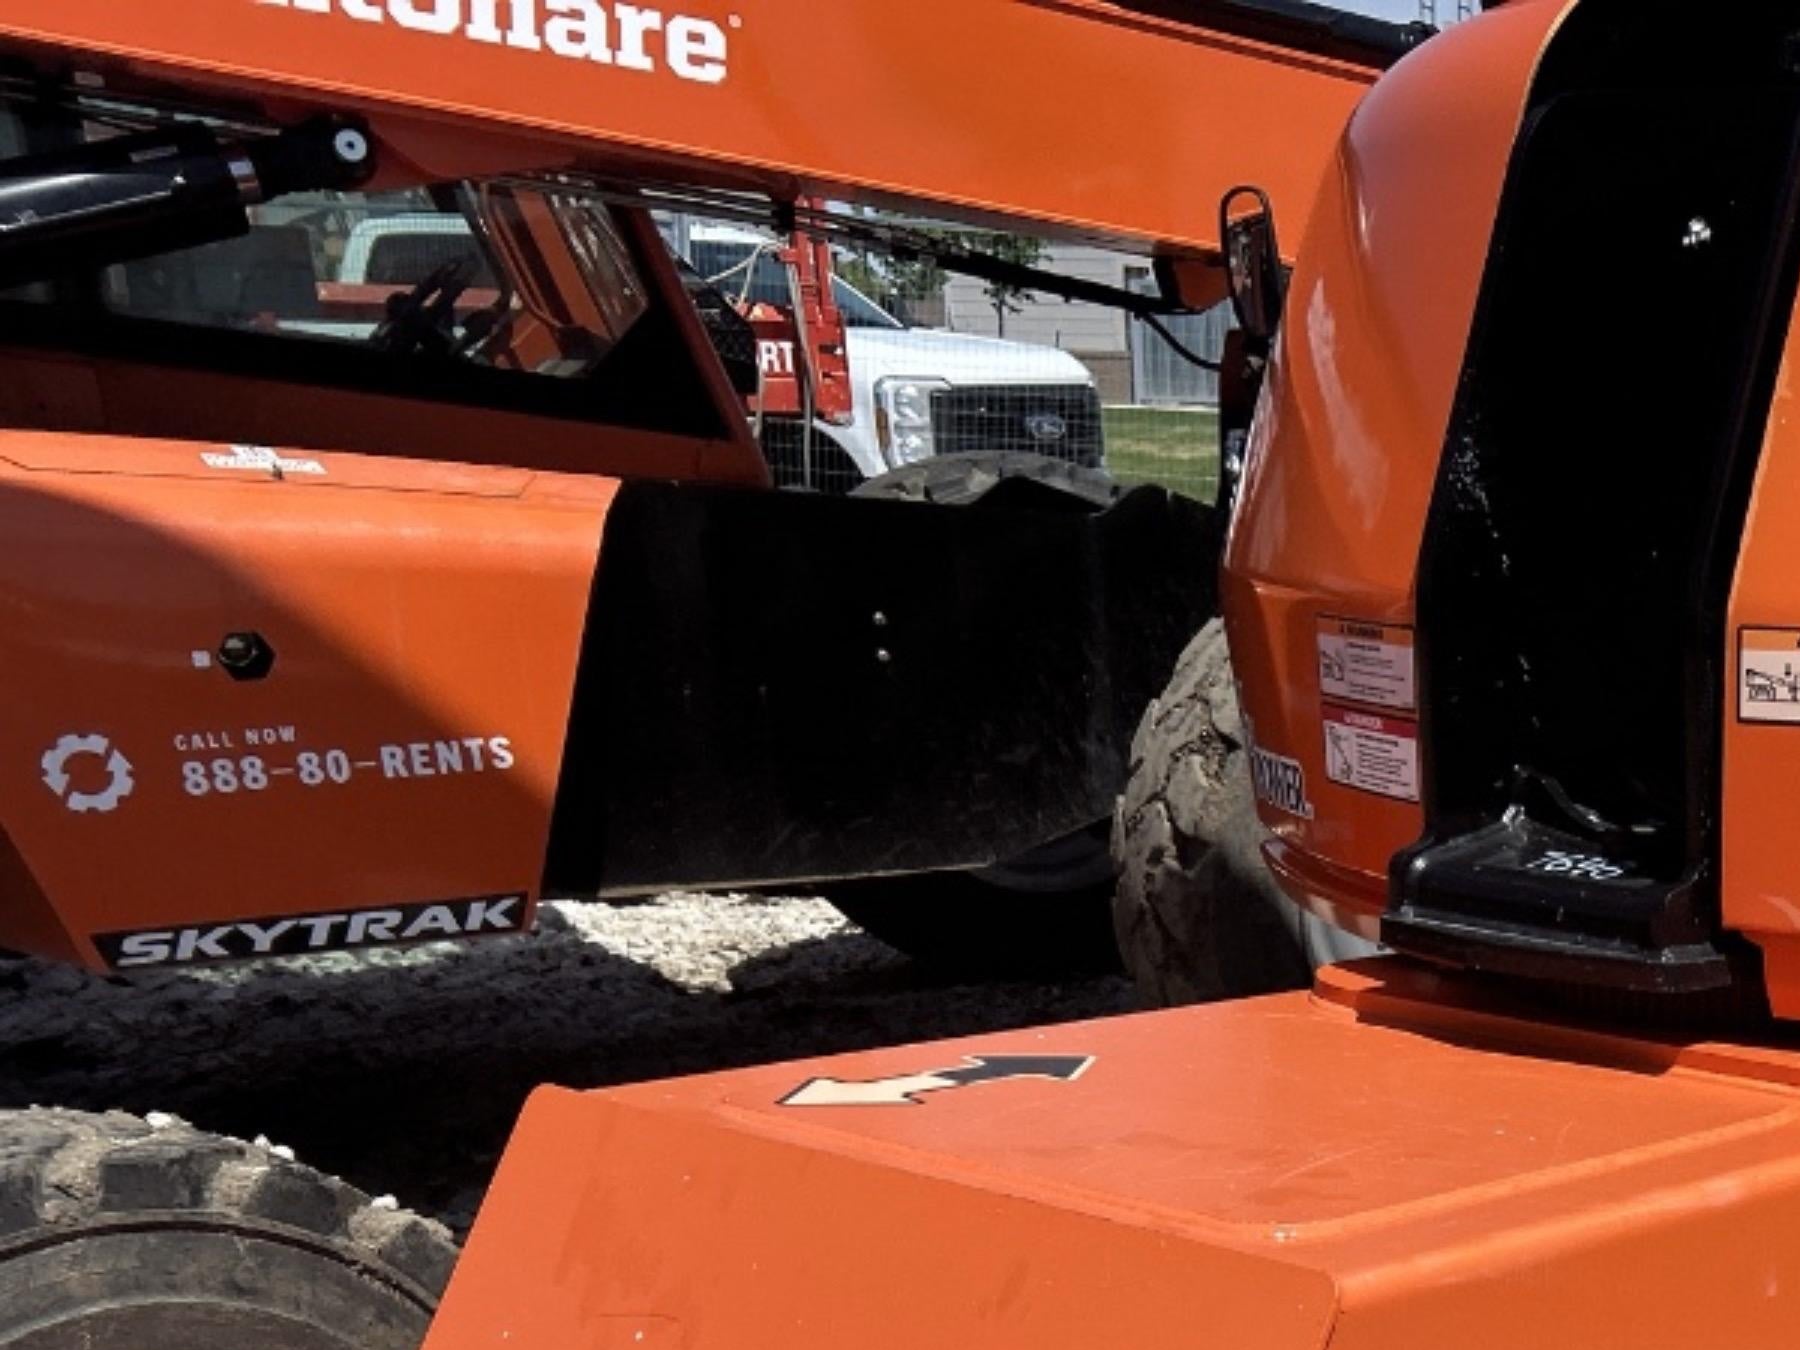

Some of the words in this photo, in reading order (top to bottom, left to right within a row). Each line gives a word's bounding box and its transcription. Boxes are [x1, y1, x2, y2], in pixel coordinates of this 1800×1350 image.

[174, 734, 234, 750] CALL
[245, 725, 296, 745] NOW
[182, 736, 515, 796] 888-80-RENTS
[118, 897, 520, 966] SKYTRAK
